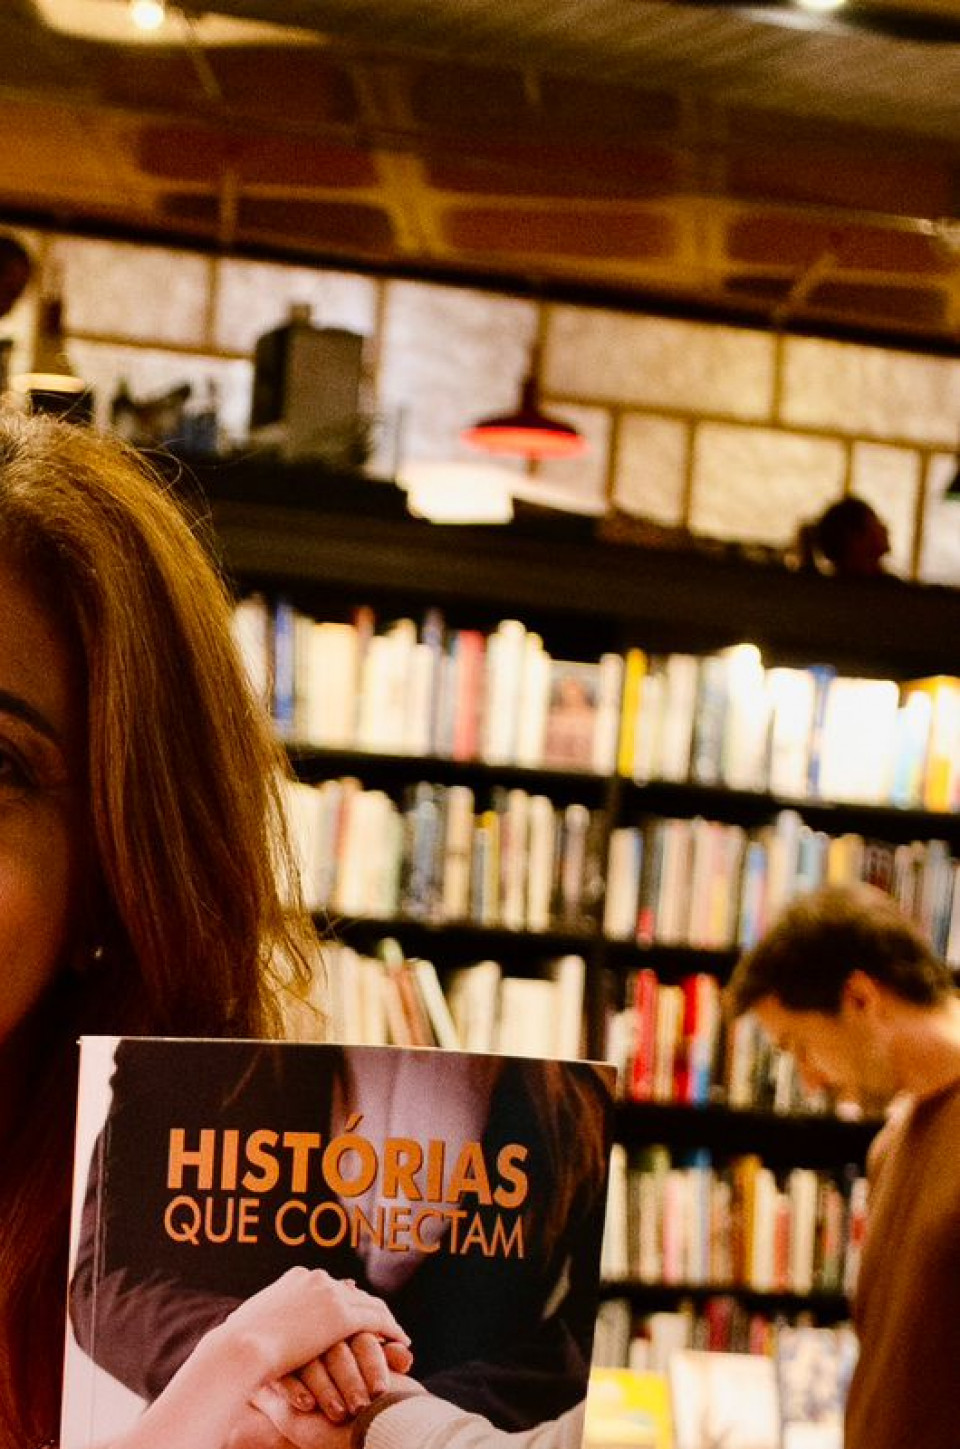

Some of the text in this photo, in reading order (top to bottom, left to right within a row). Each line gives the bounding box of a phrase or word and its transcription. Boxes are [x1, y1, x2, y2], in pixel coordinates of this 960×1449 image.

[167, 1114, 528, 1209] HISTÓRIAS
[164, 1195, 524, 1260] QUE CONECTAM
